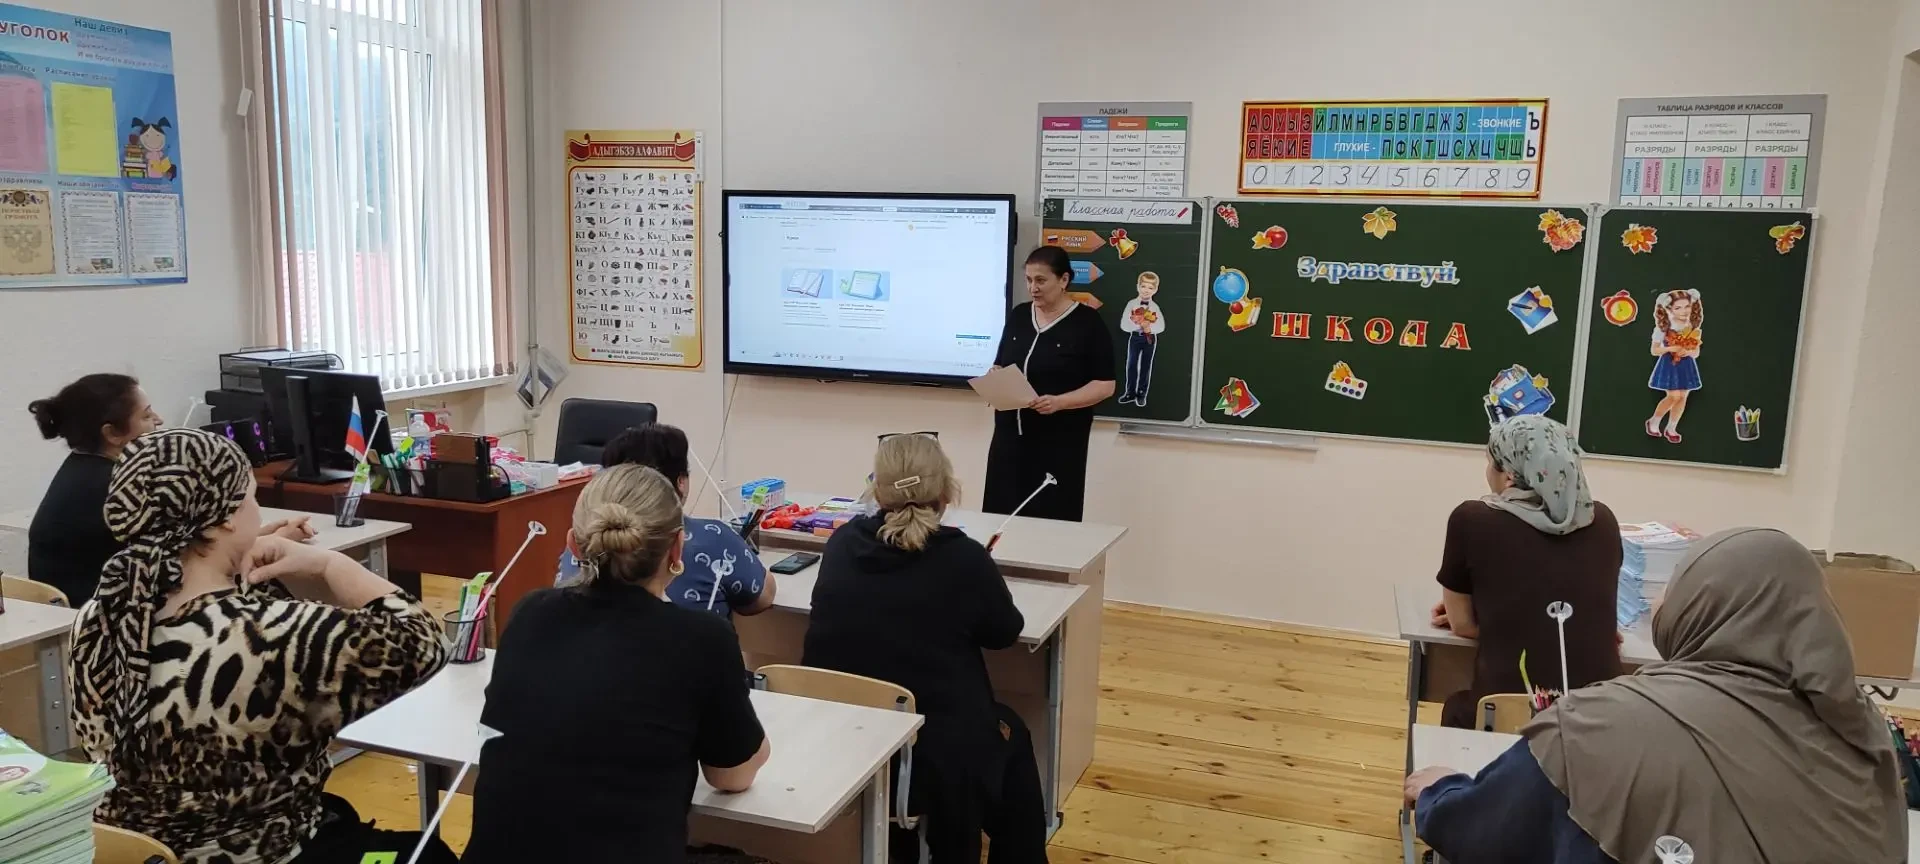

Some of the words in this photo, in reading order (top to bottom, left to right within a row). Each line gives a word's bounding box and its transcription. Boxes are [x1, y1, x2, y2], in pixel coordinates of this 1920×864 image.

[1478, 119, 1521, 127] ЗВОНКИЕ
[1529, 112, 1539, 130] Ъ
[1334, 143, 1370, 151] ГЛУХИЕ
[1527, 140, 1536, 157] Ь
[1253, 166, 1267, 184] 0
[1285, 166, 1295, 184] 1
[1309, 166, 1323, 184] 2
[1336, 166, 1350, 184] 3
[1362, 166, 1379, 184] 4
[1392, 168, 1410, 186] 5
[1424, 168, 1440, 187] 6
[1454, 168, 1470, 186] 7
[1485, 169, 1500, 188] 8
[1513, 169, 1530, 188] 9
[1068, 200, 1124, 215] Классная
[1127, 203, 1176, 220] работа
